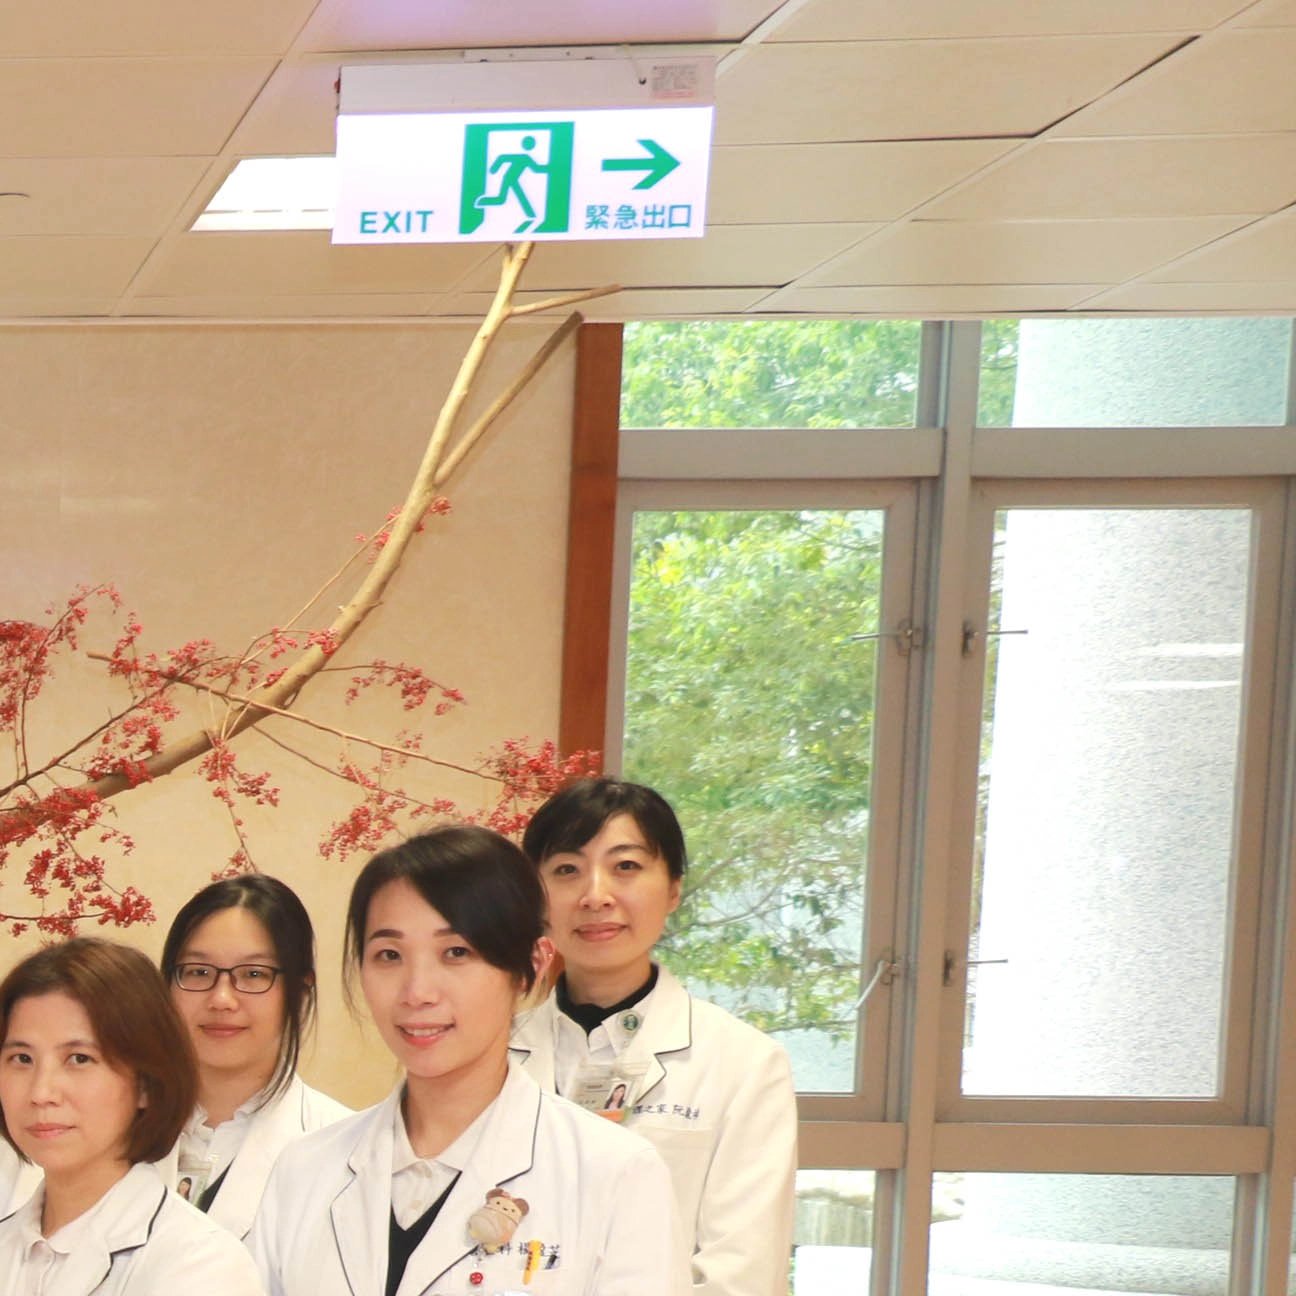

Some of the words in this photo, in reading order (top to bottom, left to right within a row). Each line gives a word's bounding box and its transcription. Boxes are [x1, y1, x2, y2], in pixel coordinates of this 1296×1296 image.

[360, 210, 435, 234] EXIT
[585, 204, 693, 230] 緊急出口
